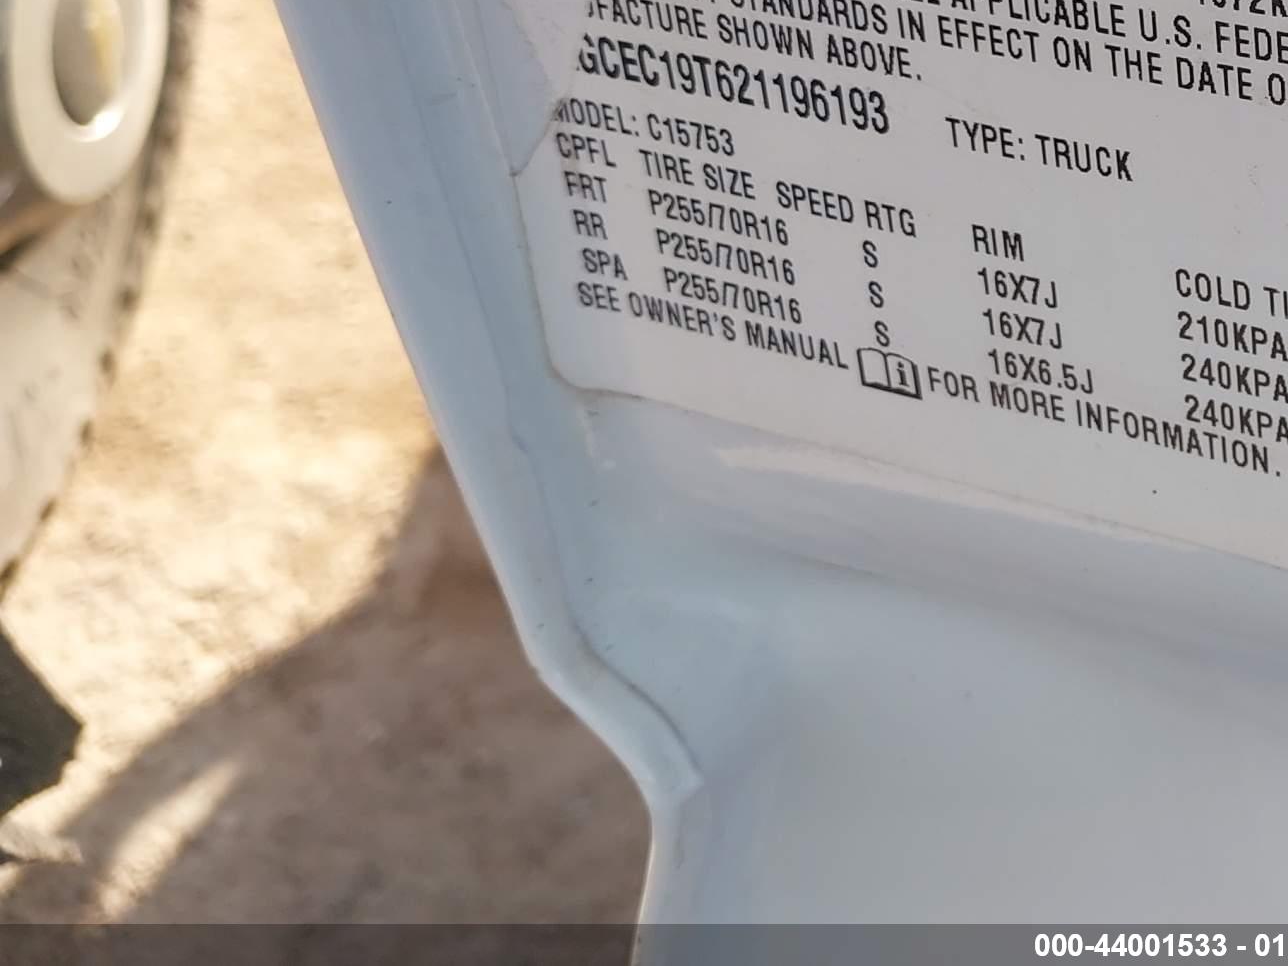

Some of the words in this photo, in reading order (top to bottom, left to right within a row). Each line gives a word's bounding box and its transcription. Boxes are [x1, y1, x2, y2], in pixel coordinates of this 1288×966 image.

[716, 13, 814, 60] SHOWN
[827, 34, 922, 81] ABOVE.
[1138, 8, 1201, 50] U.S.
[897, 8, 926, 42] IN
[937, 15, 1039, 63] EFFECT
[1053, 36, 1092, 72] ON
[1104, 42, 1163, 85] THE
[1176, 57, 1253, 101] DATE
[576, 33, 890, 134] GCEC19T621196193
[646, 113, 735, 157] C15753
[945, 117, 1025, 161] TYPE:
[1034, 134, 1133, 182] TRUCK
[555, 132, 617, 168] CPFL
[638, 149, 694, 186] TIRE
[702, 163, 756, 200] SIZE
[776, 180, 854, 223] SPEED
[864, 200, 916, 238] RTG
[562, 170, 606, 203] FRT
[572, 209, 608, 240] RR
[647, 188, 788, 246] P255/70R16
[581, 248, 628, 281] SPA
[654, 228, 795, 286] P255/70R16
[862, 240, 878, 268] S
[971, 224, 1024, 262] RIM
[662, 266, 802, 324] P255/70R16
[868, 280, 884, 308] S
[977, 267, 1058, 309] 16X7J
[1175, 268, 1250, 310] COLD
[874, 320, 890, 347] S
[982, 308, 1062, 349] 16X7J
[576, 281, 621, 312] SEE
[628, 292, 736, 341] OWNER'S
[745, 320, 849, 370] MANUAL
[927, 366, 980, 403] FOR
[989, 380, 1065, 422] MORE
[1075, 402, 1280, 477] INFORMATION.
[988, 348, 1093, 394] 16X6.5J
